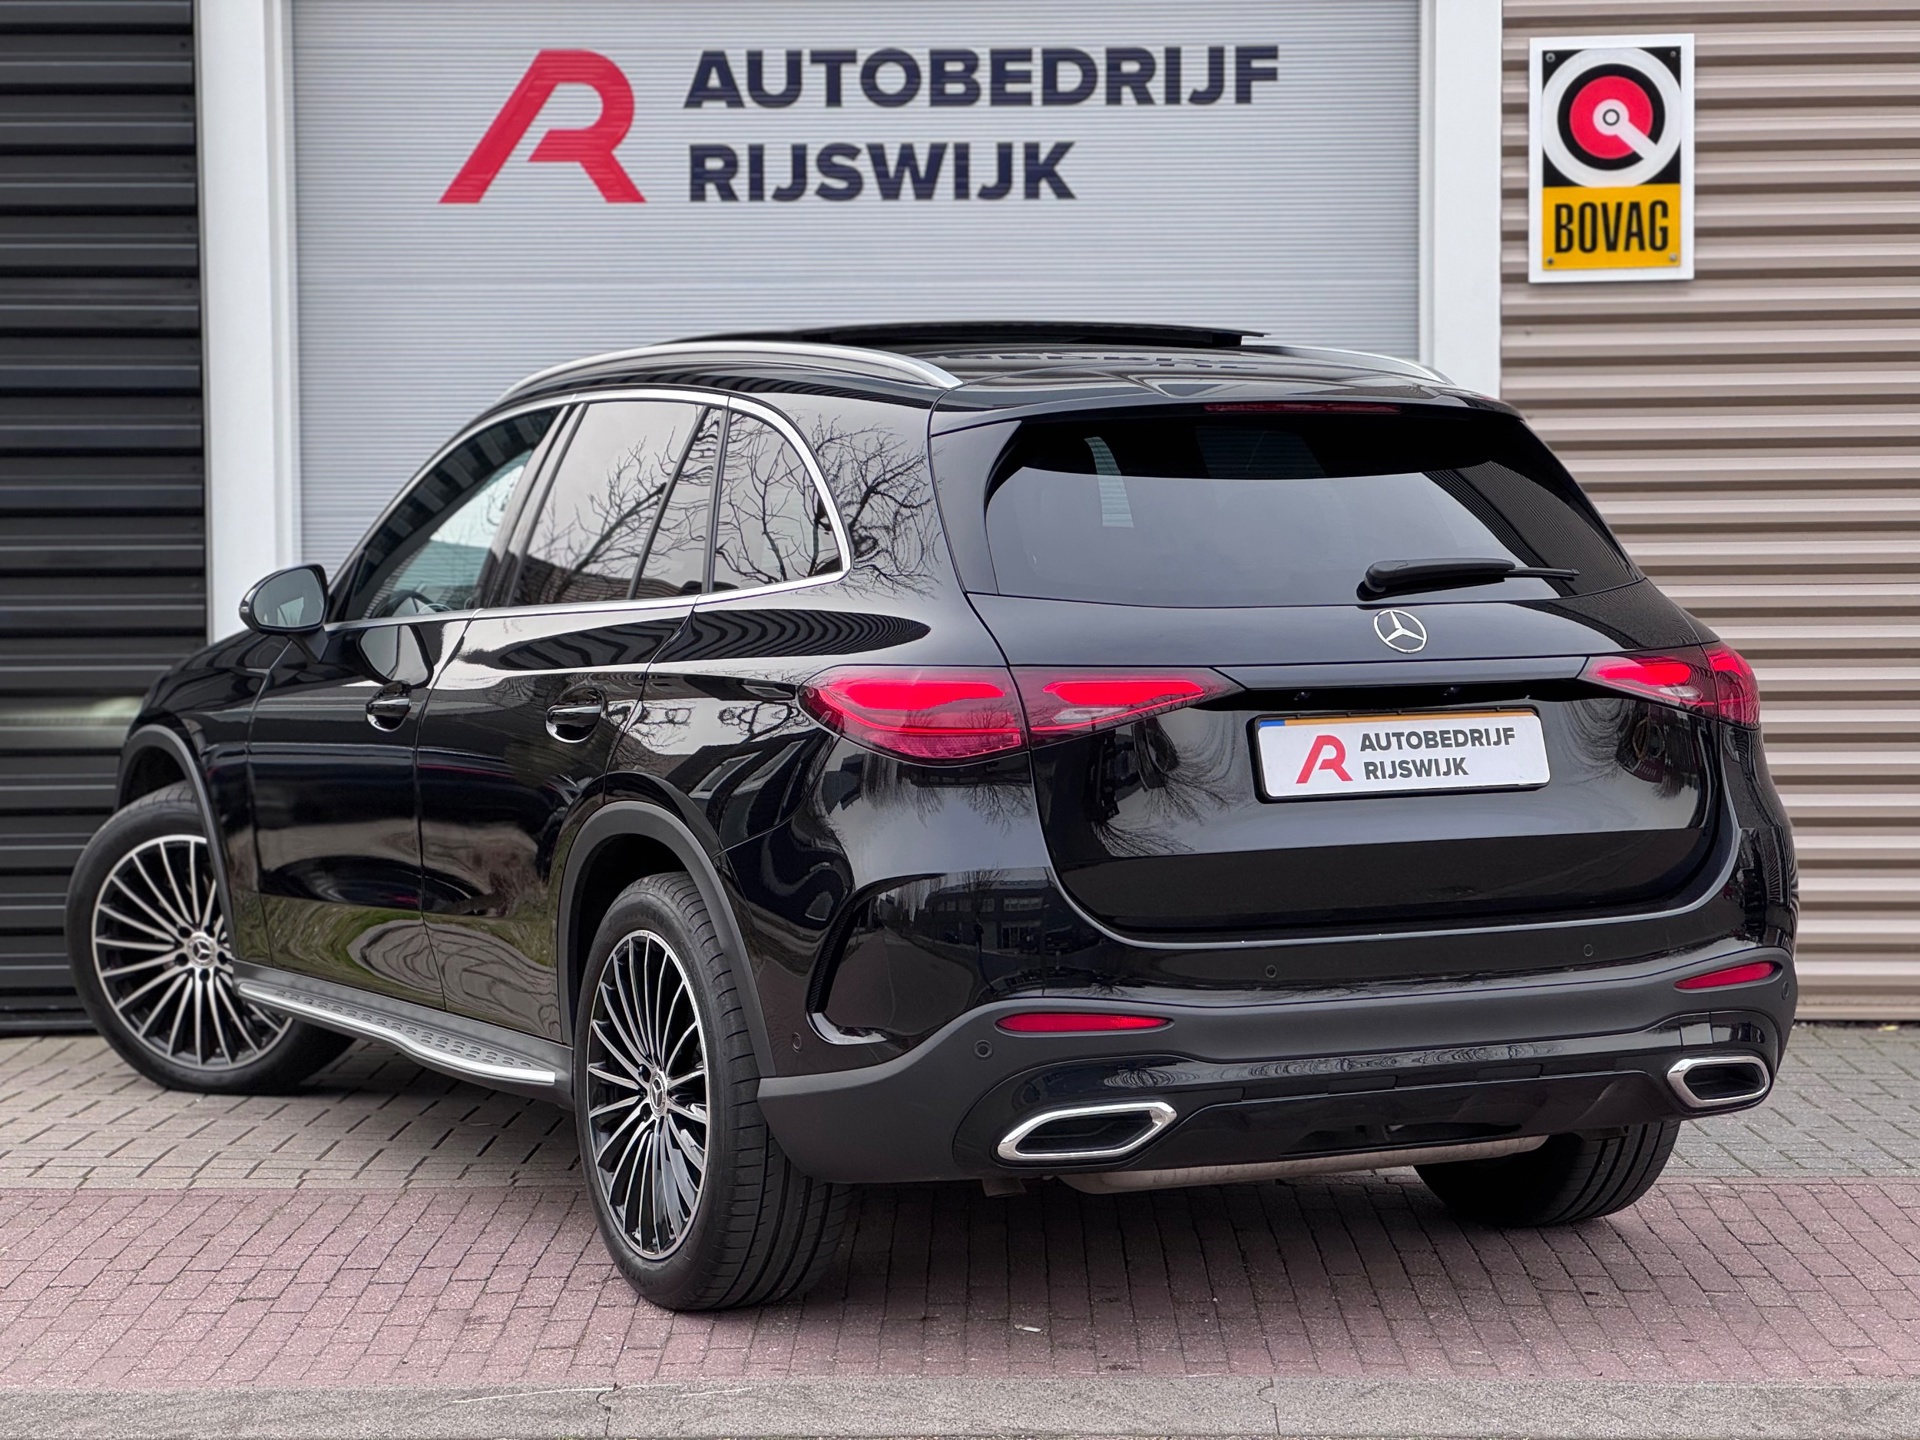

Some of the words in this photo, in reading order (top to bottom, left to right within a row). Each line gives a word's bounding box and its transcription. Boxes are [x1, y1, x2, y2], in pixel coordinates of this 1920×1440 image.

[683, 45, 1280, 109] AUTOBEDRIJF
[689, 141, 1077, 203] RIJSWIJK
[1554, 199, 1669, 254] BOVAG
[1360, 727, 1516, 752] AUTOBEDRIJF
[1363, 757, 1469, 780] RIJSWIJK
